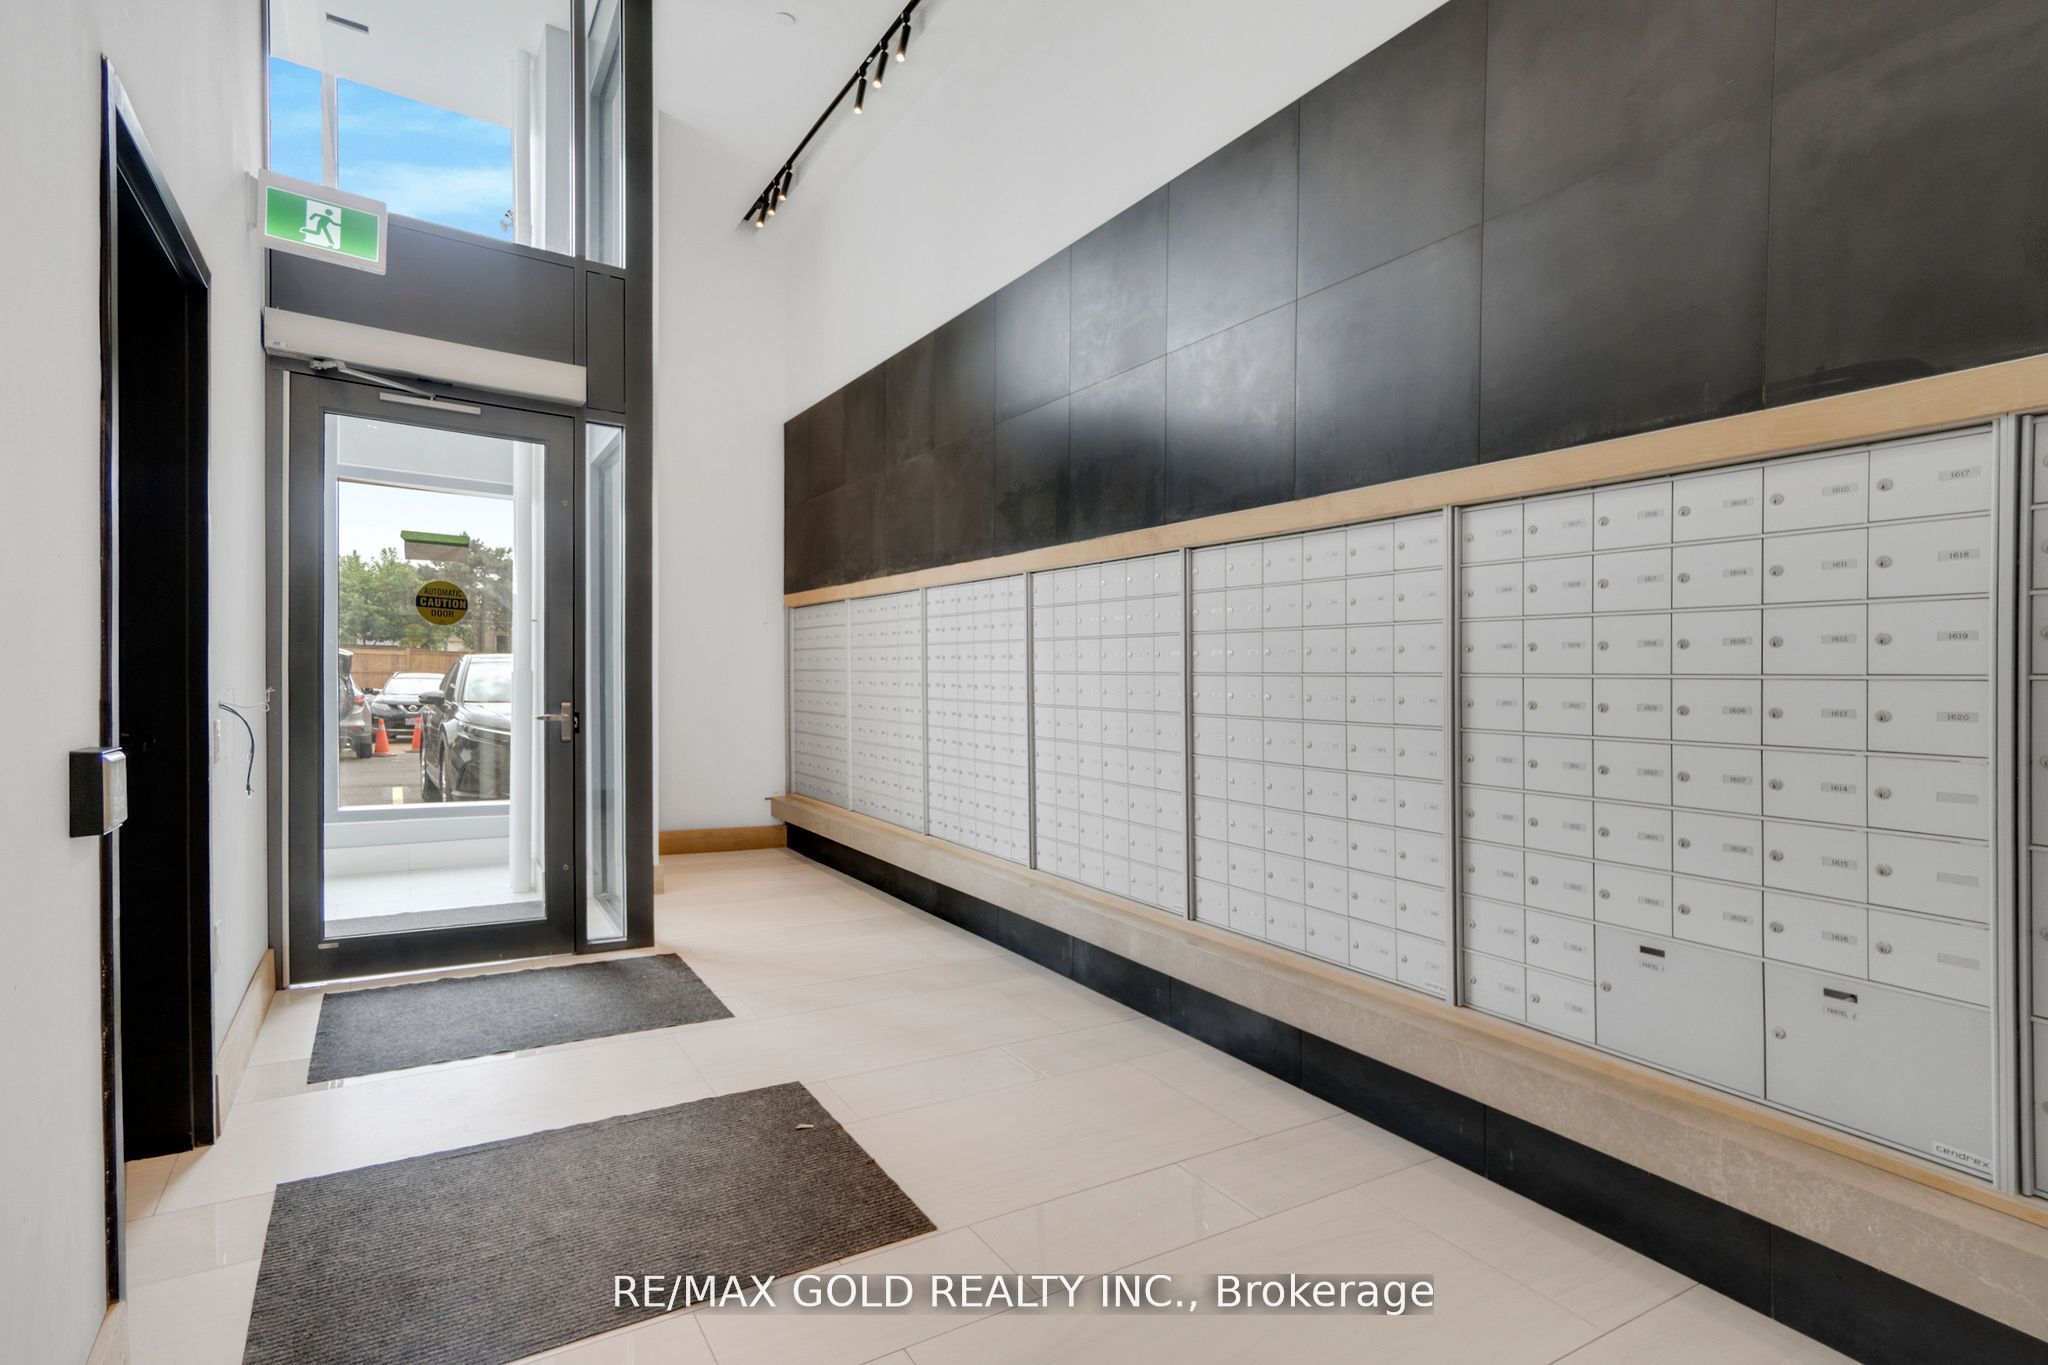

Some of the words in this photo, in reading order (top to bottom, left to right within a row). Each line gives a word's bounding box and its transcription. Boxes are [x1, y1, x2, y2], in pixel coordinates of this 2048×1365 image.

[1951, 470, 1970, 479] 1617
[1832, 486, 1850, 494] 1610
[424, 587, 462, 597] AUTOMATIC
[420, 597, 466, 610] CAUTION
[431, 610, 454, 618] DOOR
[1831, 859, 1849, 867] 1615
[1831, 934, 1848, 943] 1616
[1826, 1007, 1849, 1018] PARCEL
[1936, 1145, 1989, 1169] cendrex
